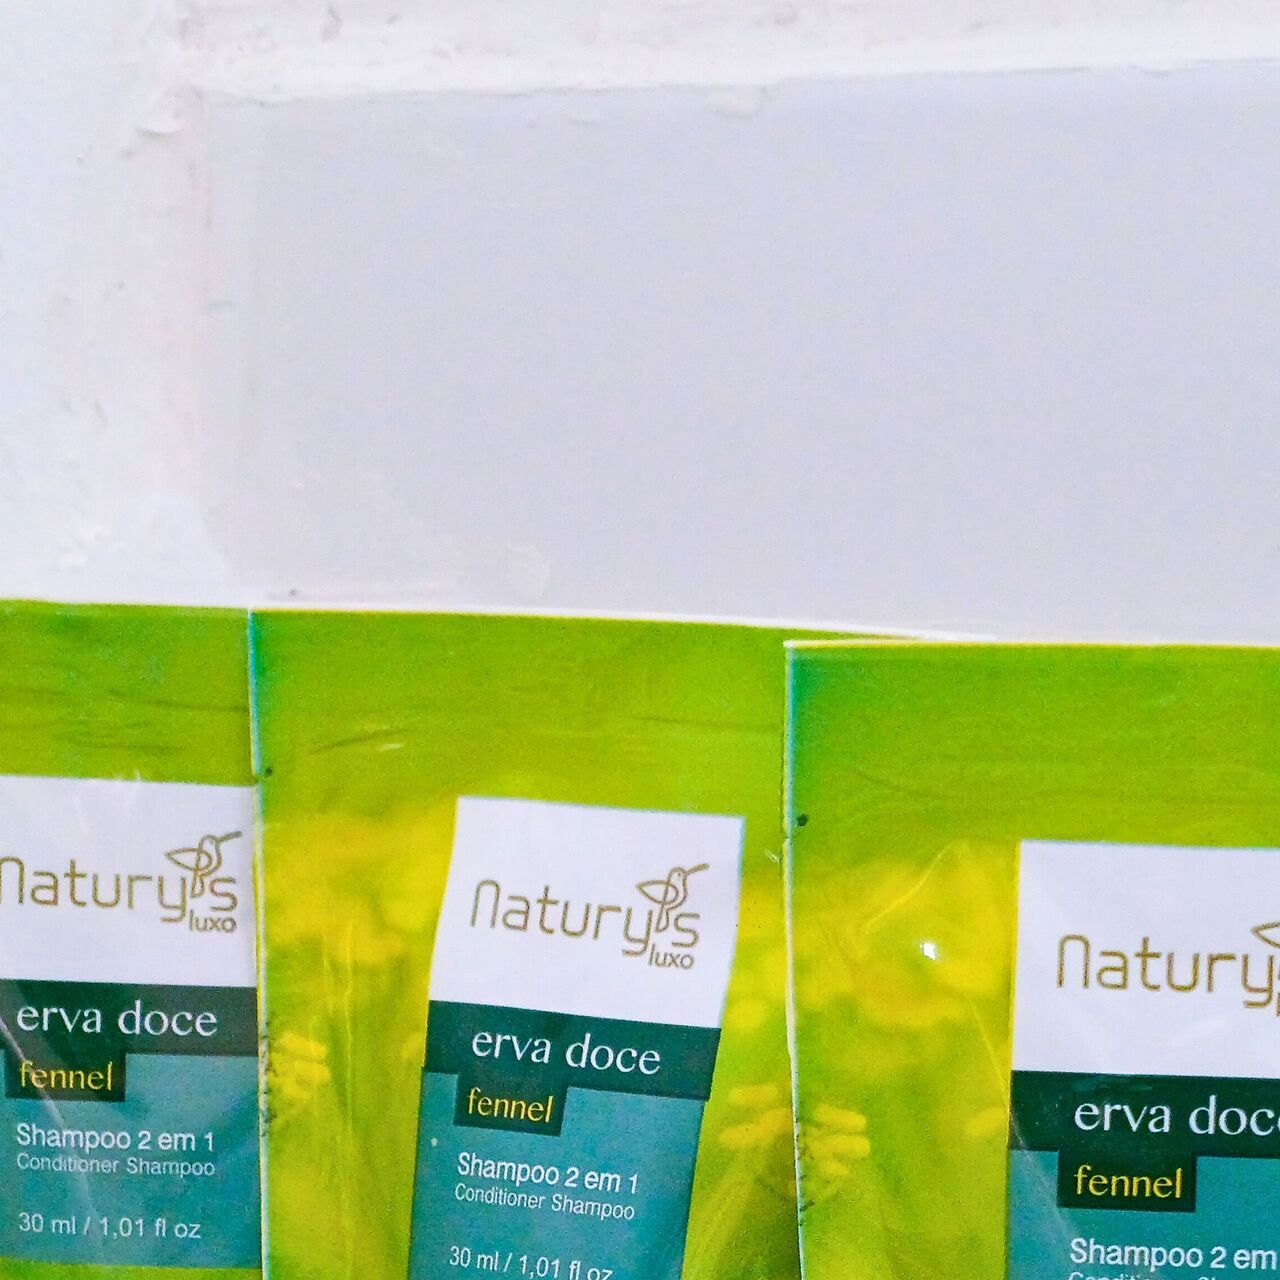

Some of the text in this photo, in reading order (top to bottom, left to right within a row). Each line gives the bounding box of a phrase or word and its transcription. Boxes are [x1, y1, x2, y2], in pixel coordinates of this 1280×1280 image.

[189, 910, 237, 934] luxo
[648, 942, 694, 969] luxo
[17, 1000, 218, 1037] erva doce
[472, 1031, 661, 1075] erva doce
[19, 1062, 112, 1091] fennel
[467, 1088, 553, 1123] fennel
[1075, 1101, 1171, 1133] erva
[16, 1123, 213, 1154] Shampoo 2 em 1
[17, 1152, 215, 1178] Conditioner Shampoo
[458, 1152, 639, 1194] Shampoo 2 em 1
[1075, 1165, 1183, 1199] fennel
[455, 1183, 635, 1220] Conditioner Shampoo
[19, 1212, 201, 1239] 30 ml / 1,01 fl oz
[449, 1246, 471, 1268] 30
[477, 1252, 499, 1271] ml
[503, 1253, 512, 1272] /
[519, 1255, 560, 1279] 1,01
[569, 1261, 581, 1280] fl
[1070, 1238, 1203, 1272] Shampoo
[1210, 1246, 1226, 1269] 2
[1233, 1248, 1278, 1271] em
